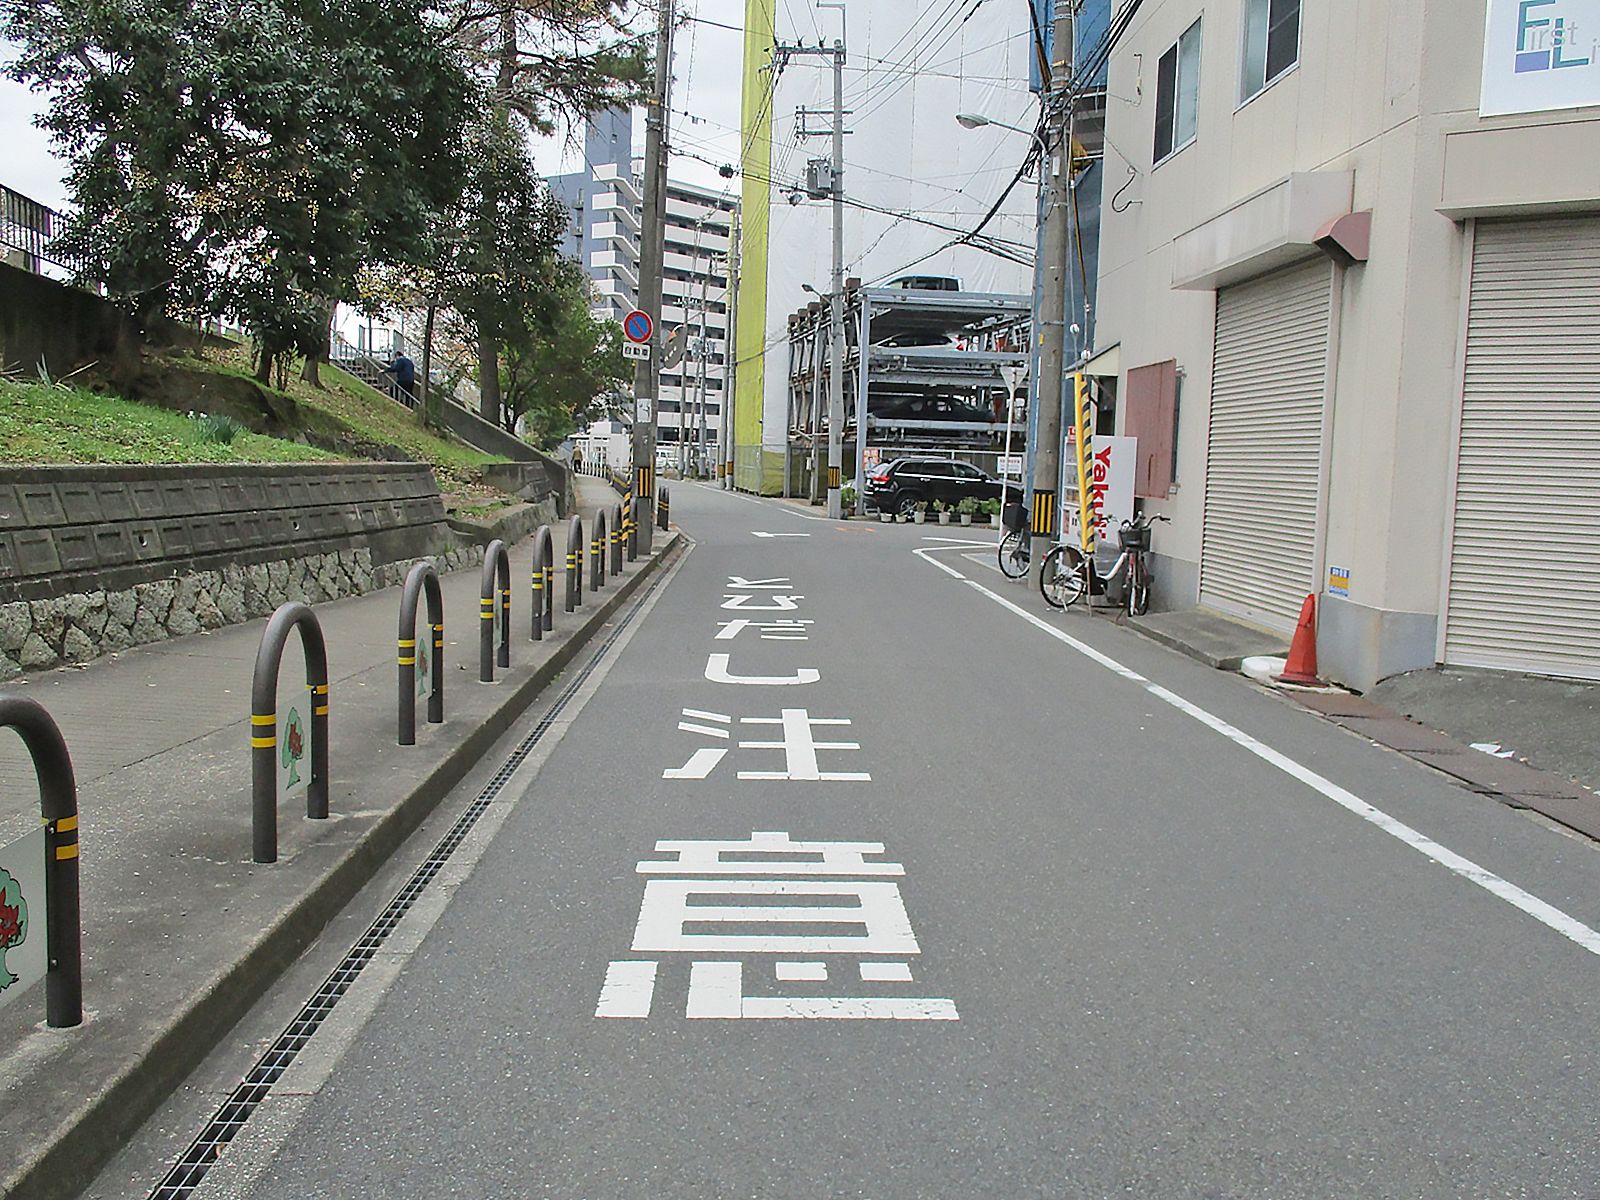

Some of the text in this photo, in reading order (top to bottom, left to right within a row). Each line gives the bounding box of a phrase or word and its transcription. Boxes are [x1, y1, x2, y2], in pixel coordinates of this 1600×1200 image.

[1517, 0, 1578, 51] First
[1553, 18, 1600, 69] Li
[595, 576, 959, 1020] とびだし注意
